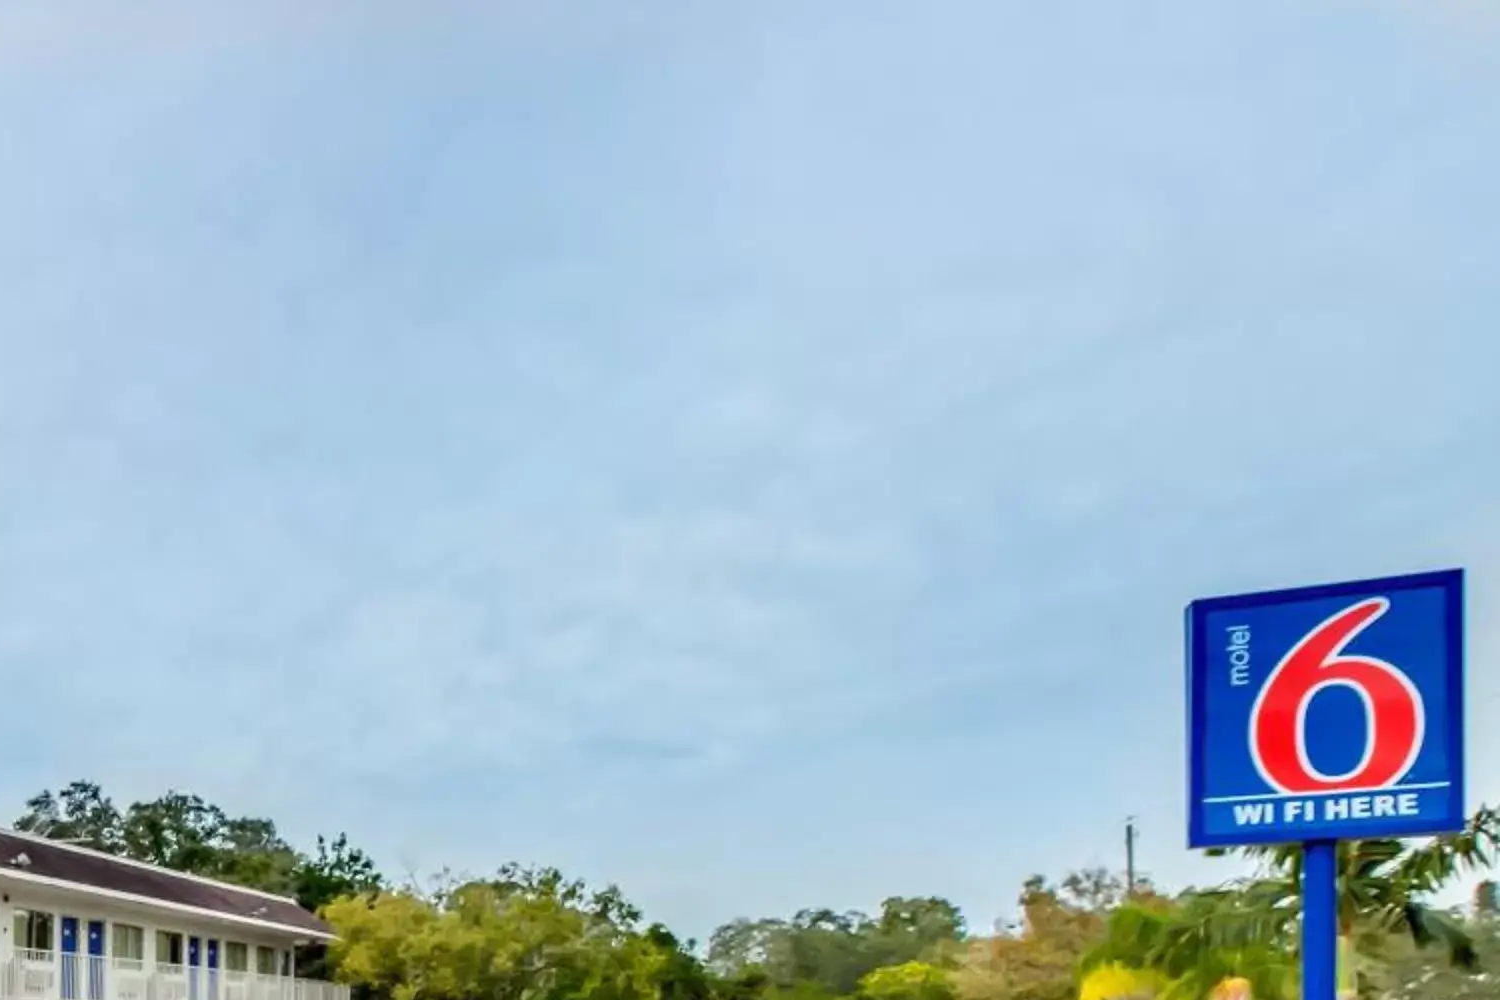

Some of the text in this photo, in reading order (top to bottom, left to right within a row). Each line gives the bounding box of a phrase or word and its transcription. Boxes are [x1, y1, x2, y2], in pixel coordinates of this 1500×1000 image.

[1225, 625, 1251, 687] motel
[1248, 596, 1425, 796] 6
[1233, 793, 1420, 826] WI FI HERE
